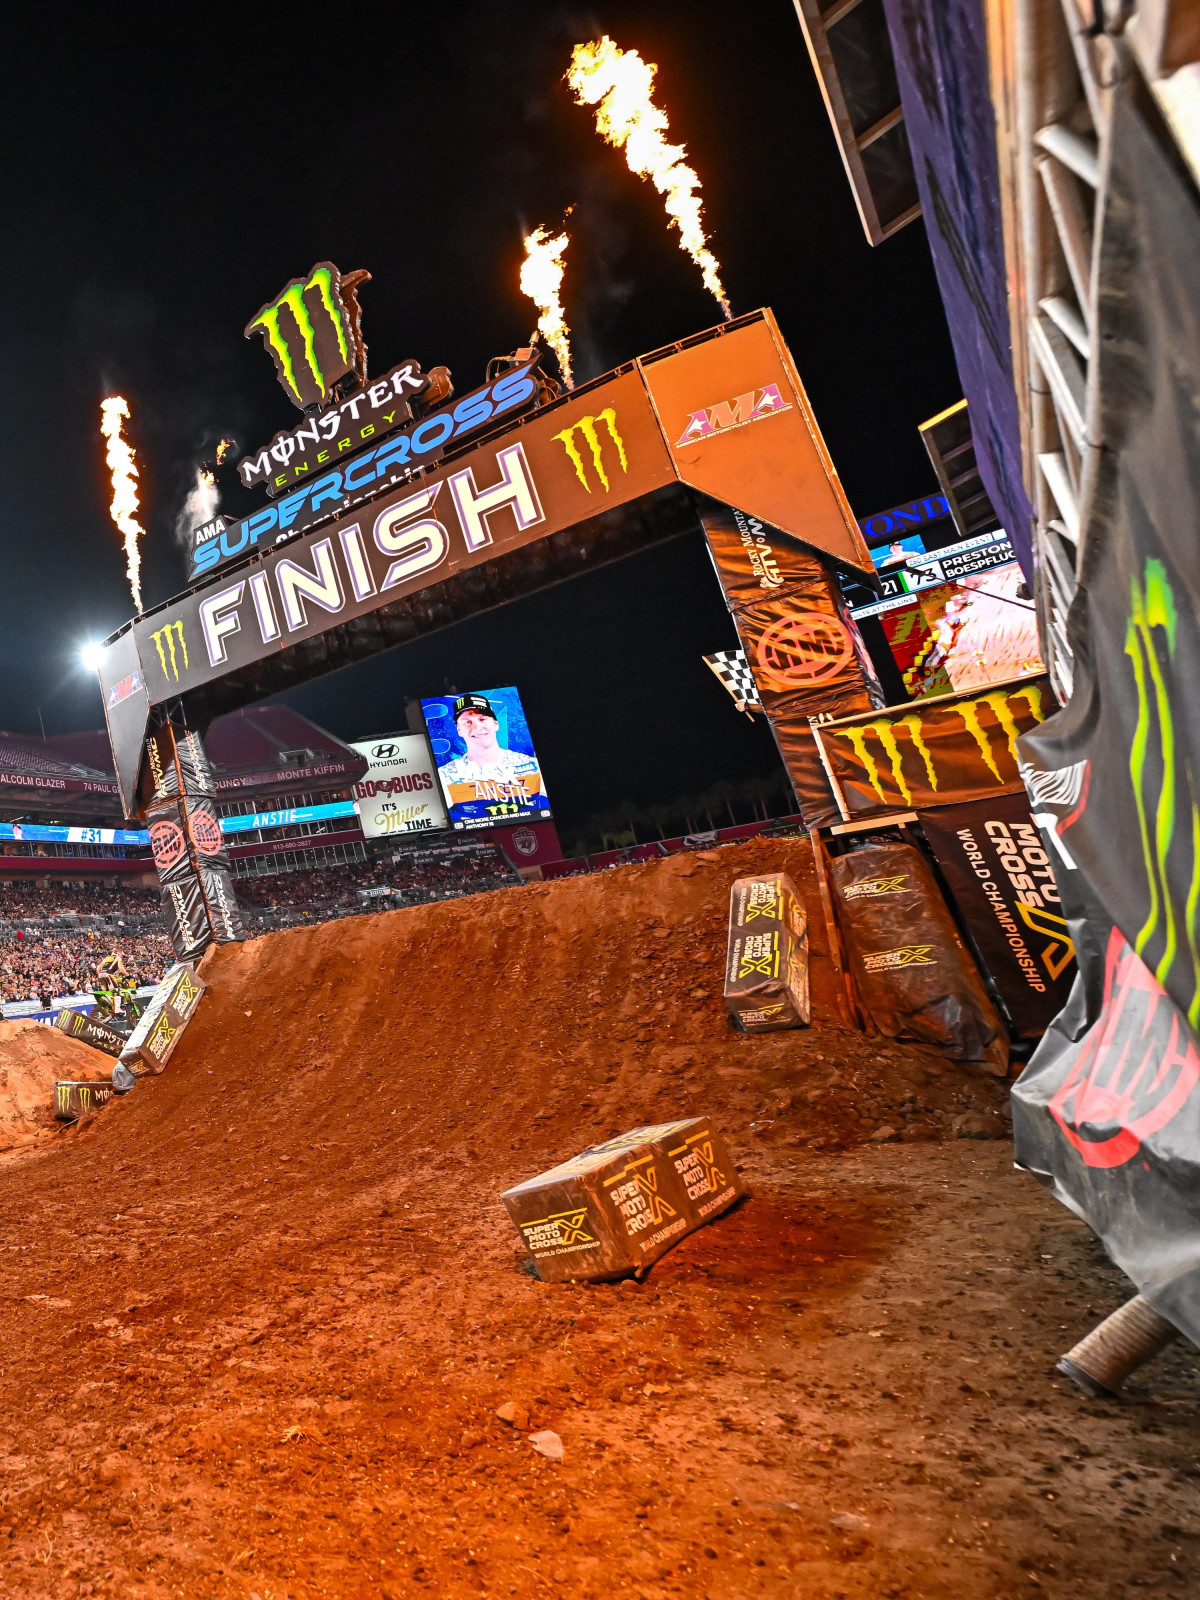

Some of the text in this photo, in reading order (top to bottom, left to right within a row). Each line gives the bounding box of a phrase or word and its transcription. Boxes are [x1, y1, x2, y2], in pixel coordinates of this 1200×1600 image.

[674, 382, 793, 445] AMA
[275, 410, 397, 487] ENERGY
[192, 364, 537, 576] SUPERCROSS
[858, 499, 950, 538] OND
[195, 518, 227, 546] AMA
[732, 508, 766, 577] ROCKY MOUNTA
[199, 441, 546, 668] FINISH
[942, 541, 1013, 569] PRESTON
[943, 545, 964, 556] MAIN
[965, 535, 991, 549] EVENT
[881, 579, 898, 596] 21
[881, 602, 897, 611] THE
[897, 596, 914, 606] LINE
[277, 763, 346, 781] MONTE KIFFIN
[369, 758, 408, 769] HYUNDAI
[35, 776, 66, 789] GLAZER
[83, 782, 112, 794] 74 PAUL
[356, 772, 434, 799] GO BUCS
[474, 780, 534, 807] ANSTIE
[374, 803, 429, 833] Miller
[382, 803, 397, 812] IT'S
[252, 811, 297, 828] ANSTIE
[404, 818, 432, 832] TIME
[80, 828, 101, 843] #31
[984, 820, 1045, 908] CROSS
[956, 828, 1047, 993] WORLD CHAMPIONSHIP
[674, 1151, 699, 1174] SUPER
[683, 1166, 703, 1186] MOTO
[610, 1180, 641, 1206] SUPER
[687, 1178, 711, 1200] CROSS
[619, 1195, 647, 1217] MOTO
[523, 1221, 559, 1237] SUPER
[626, 1209, 654, 1236] CROSS
[528, 1230, 560, 1242] MOTO
[529, 1236, 565, 1250] CROSS
[534, 1240, 601, 1260] WORLD CHAMPIONSHIP
